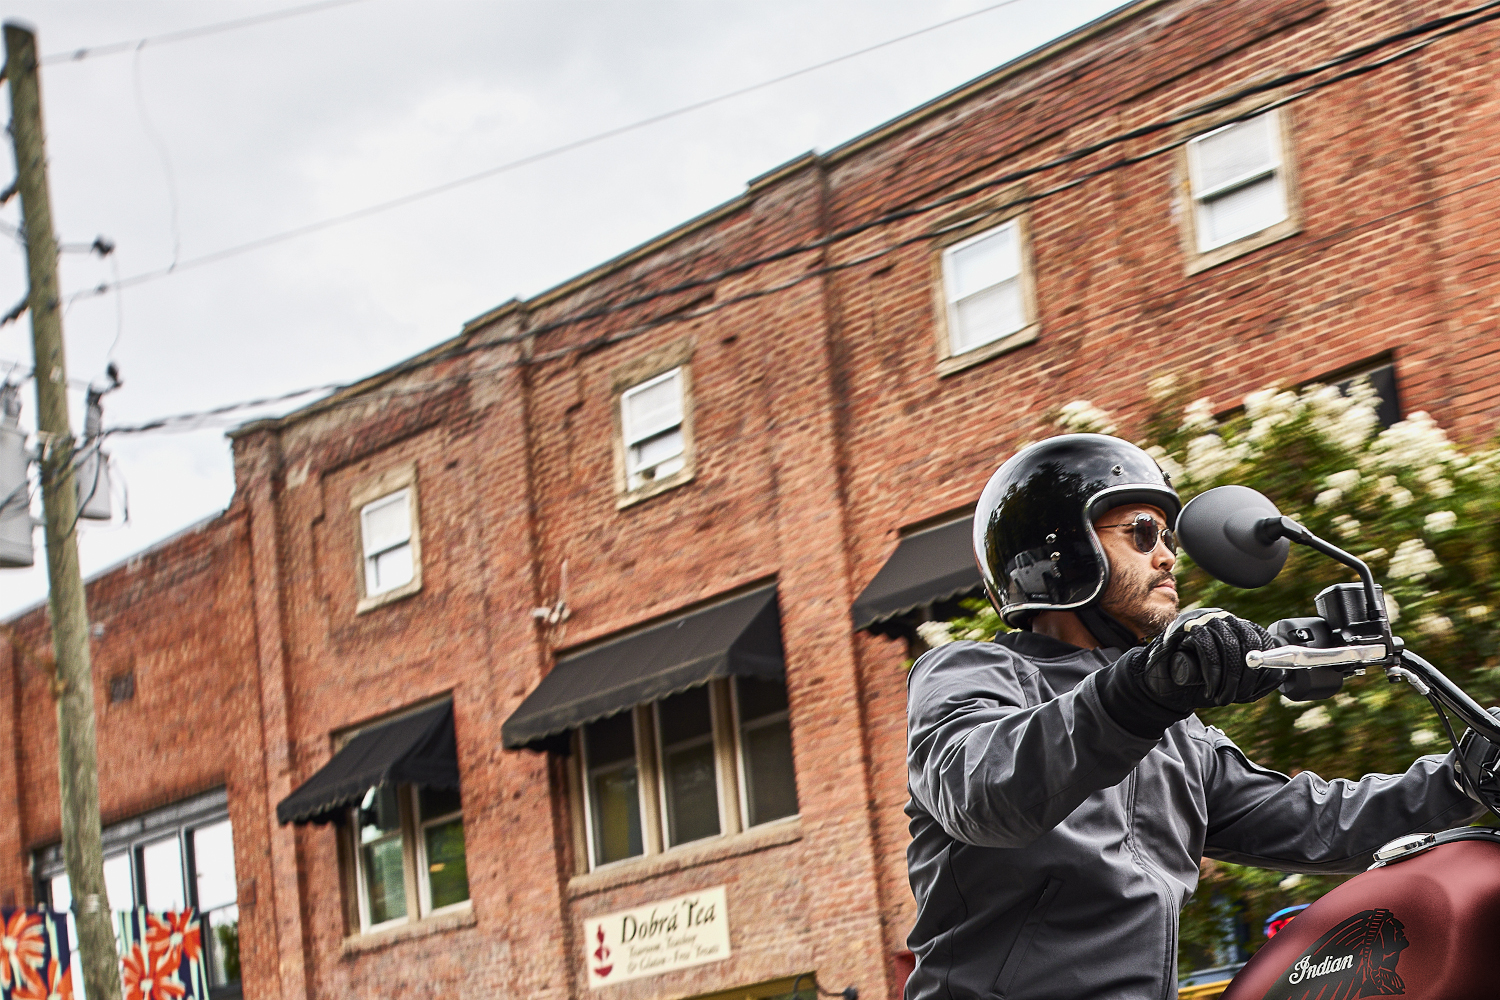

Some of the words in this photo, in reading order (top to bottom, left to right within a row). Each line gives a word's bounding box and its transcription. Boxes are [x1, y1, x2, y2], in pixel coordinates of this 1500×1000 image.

[621, 904, 677, 944] Dobrá
[682, 899, 716, 928] Tea
[1289, 955, 1353, 984] Indian
